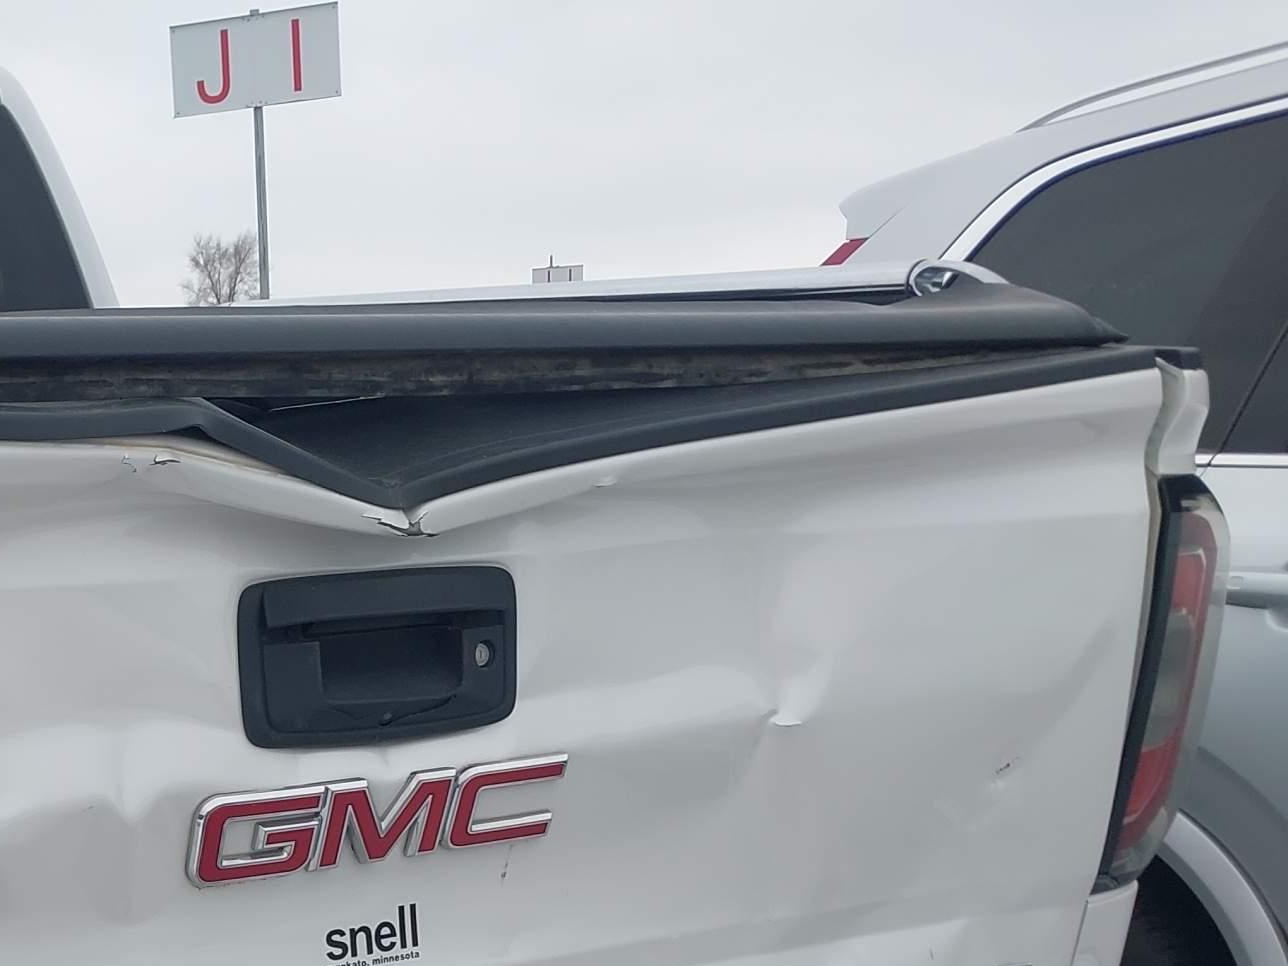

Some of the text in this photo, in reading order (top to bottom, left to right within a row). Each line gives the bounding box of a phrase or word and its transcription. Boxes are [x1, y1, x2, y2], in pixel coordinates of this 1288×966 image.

[197, 29, 231, 105] J
[185, 752, 569, 888] GMC
[325, 902, 419, 961] snell
[372, 950, 420, 966] minnesota
